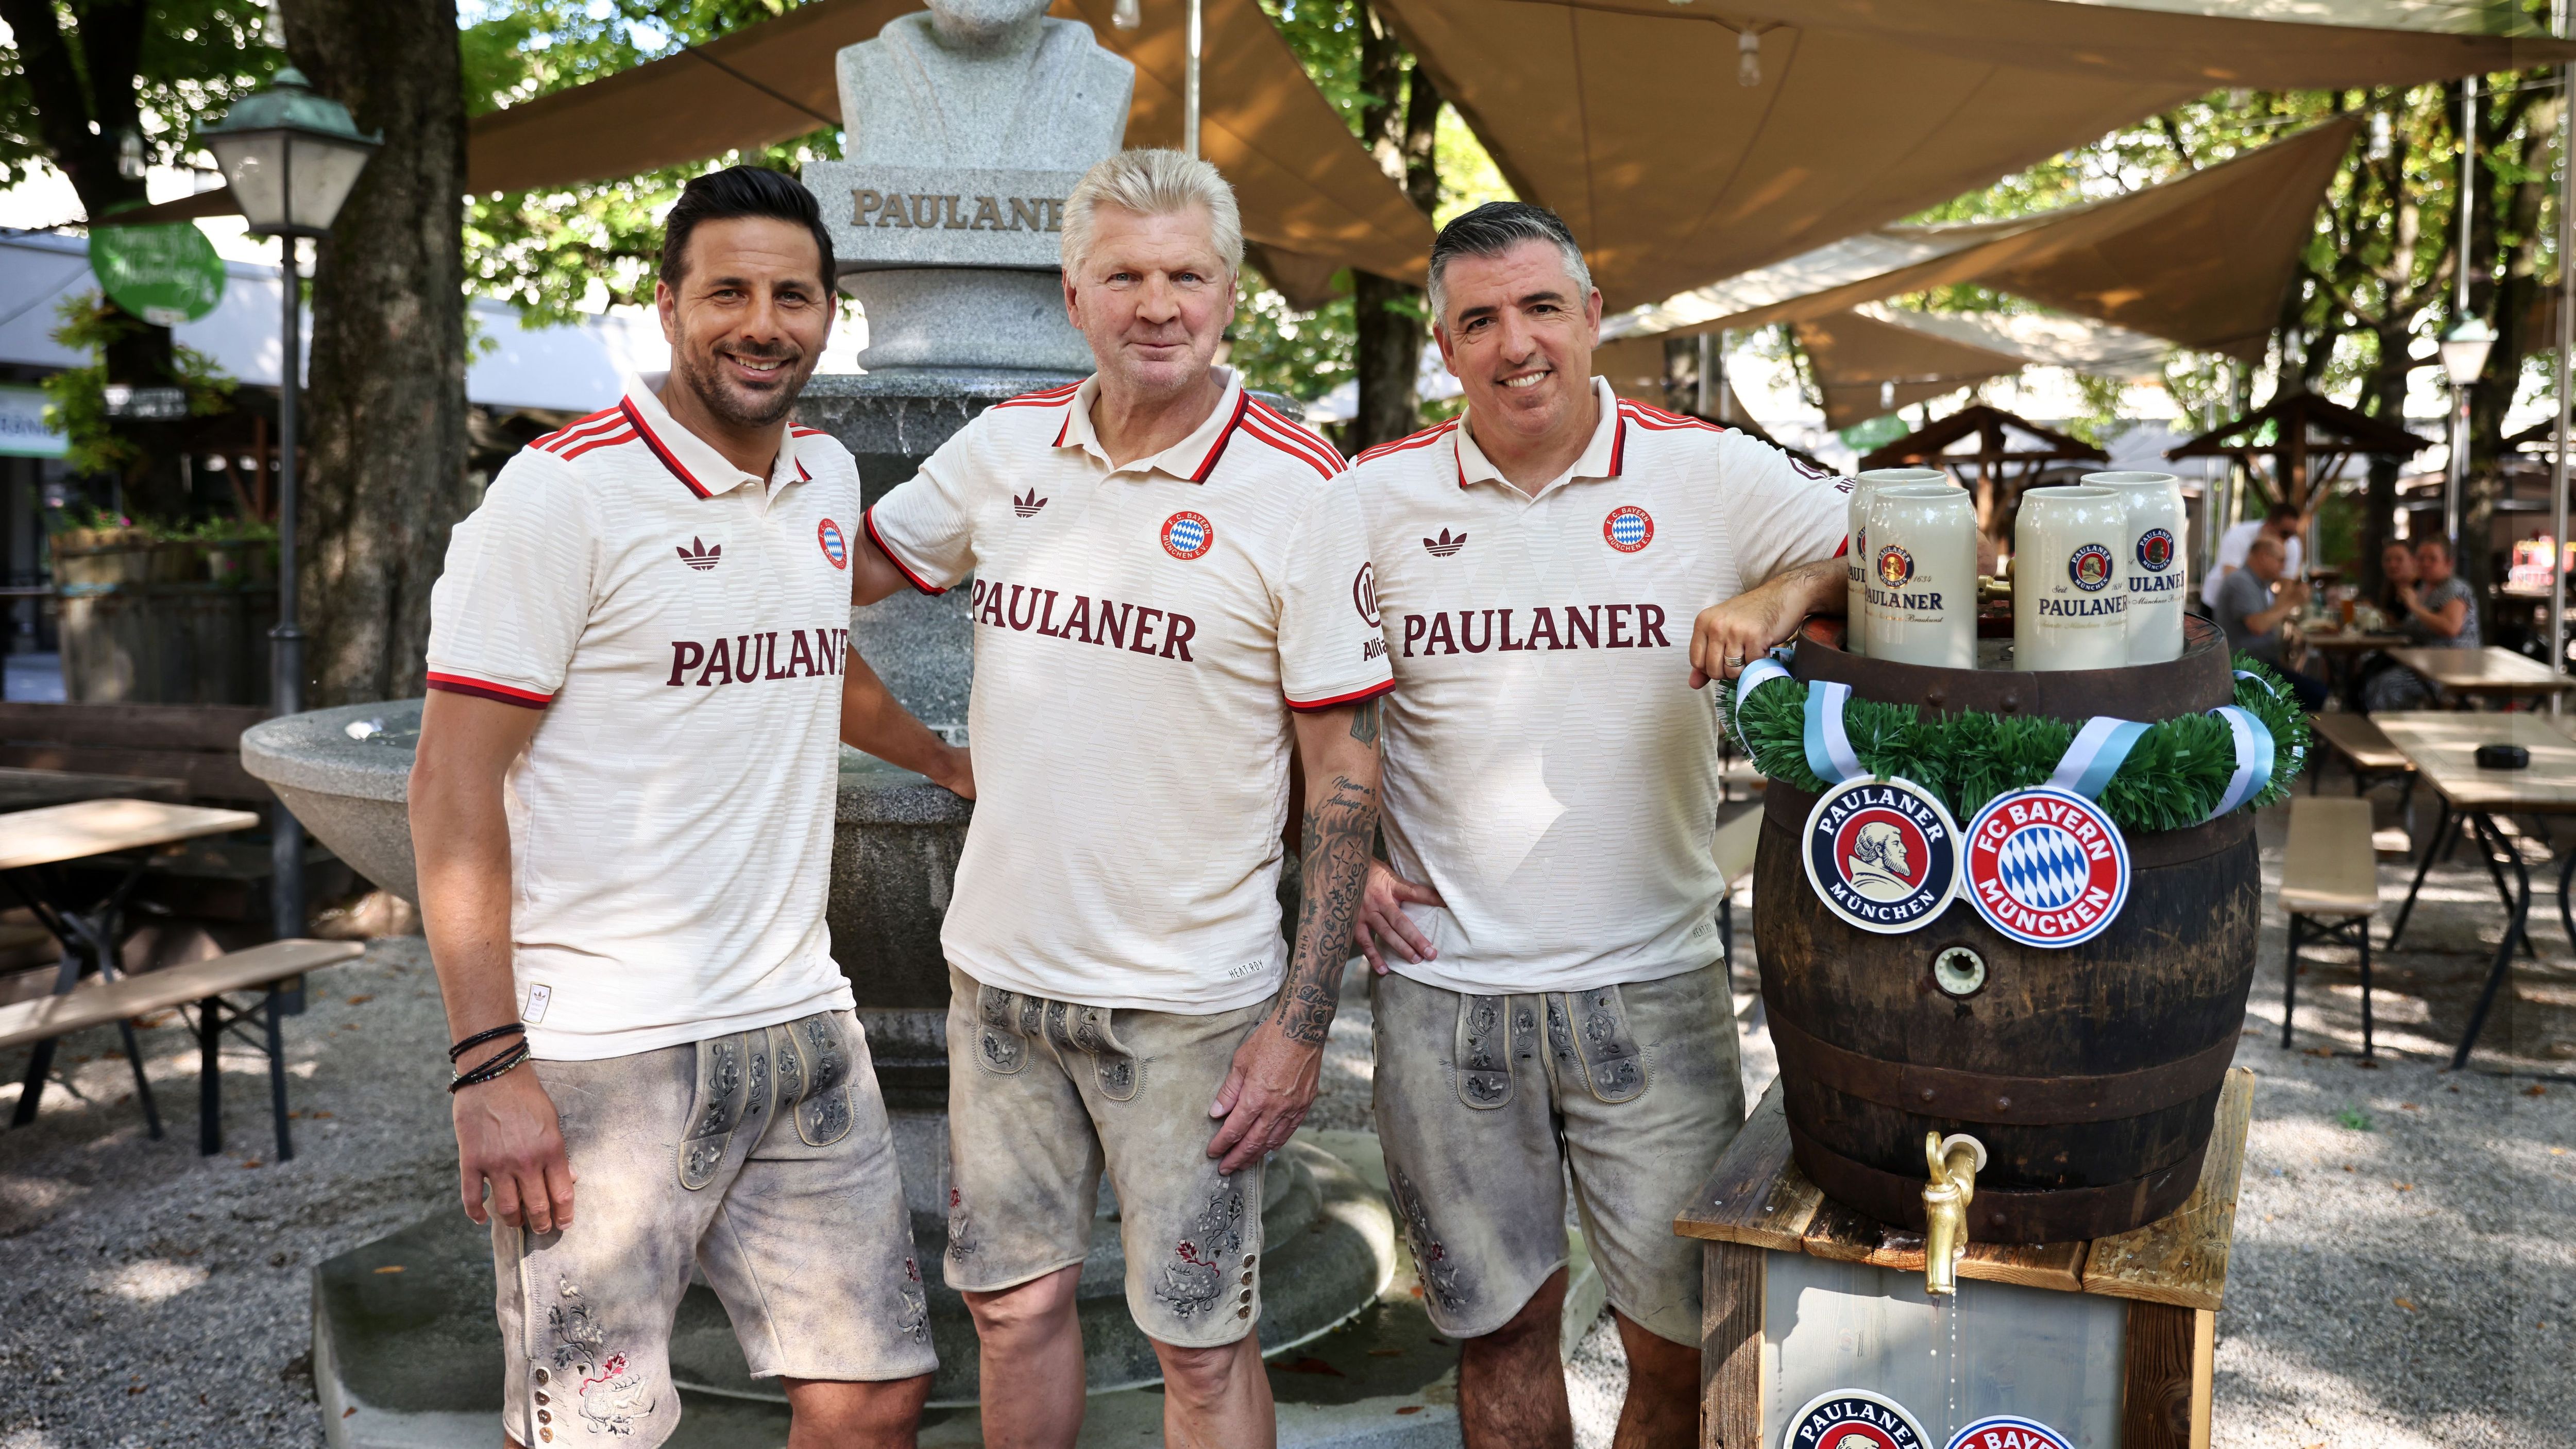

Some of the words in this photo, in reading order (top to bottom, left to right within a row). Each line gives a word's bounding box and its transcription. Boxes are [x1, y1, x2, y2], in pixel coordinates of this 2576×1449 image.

[1187, 513, 1211, 535] BAYERN
[1621, 507, 1650, 522] BAYERN
[1162, 535, 1193, 558] MÜNCHEN
[1195, 544, 1208, 556] E.V.
[1606, 535, 1642, 551] MÜNCHEN
[1641, 532, 1652, 544] E.V.
[2139, 530, 2173, 547] PAULANER
[1878, 547, 1911, 563] PAULANER
[2071, 545, 2111, 564] PAULANER
[2142, 559, 2171, 570] MÜNCHEN
[1912, 575, 1933, 583] 1634
[2052, 585, 2068, 593] Seit
[2111, 583, 2123, 591] 1634
[2074, 577, 2109, 591] MÜNCHEN
[2039, 594, 2128, 617] PAULANER
[973, 578, 1196, 662] PAULANER
[1905, 613, 1944, 623] Braukunst
[1403, 604, 1671, 658] PAULANER
[1331, 776, 1364, 791] Never
[1819, 789, 1944, 843] PAULANER
[1977, 819, 2008, 854] FC
[2007, 801, 2111, 861] BAYERN
[1829, 882, 1936, 920] MÜNCHEN
[1979, 877, 2110, 934] MÜNCHEN
[1228, 959, 1264, 979] HEAT.RDY
